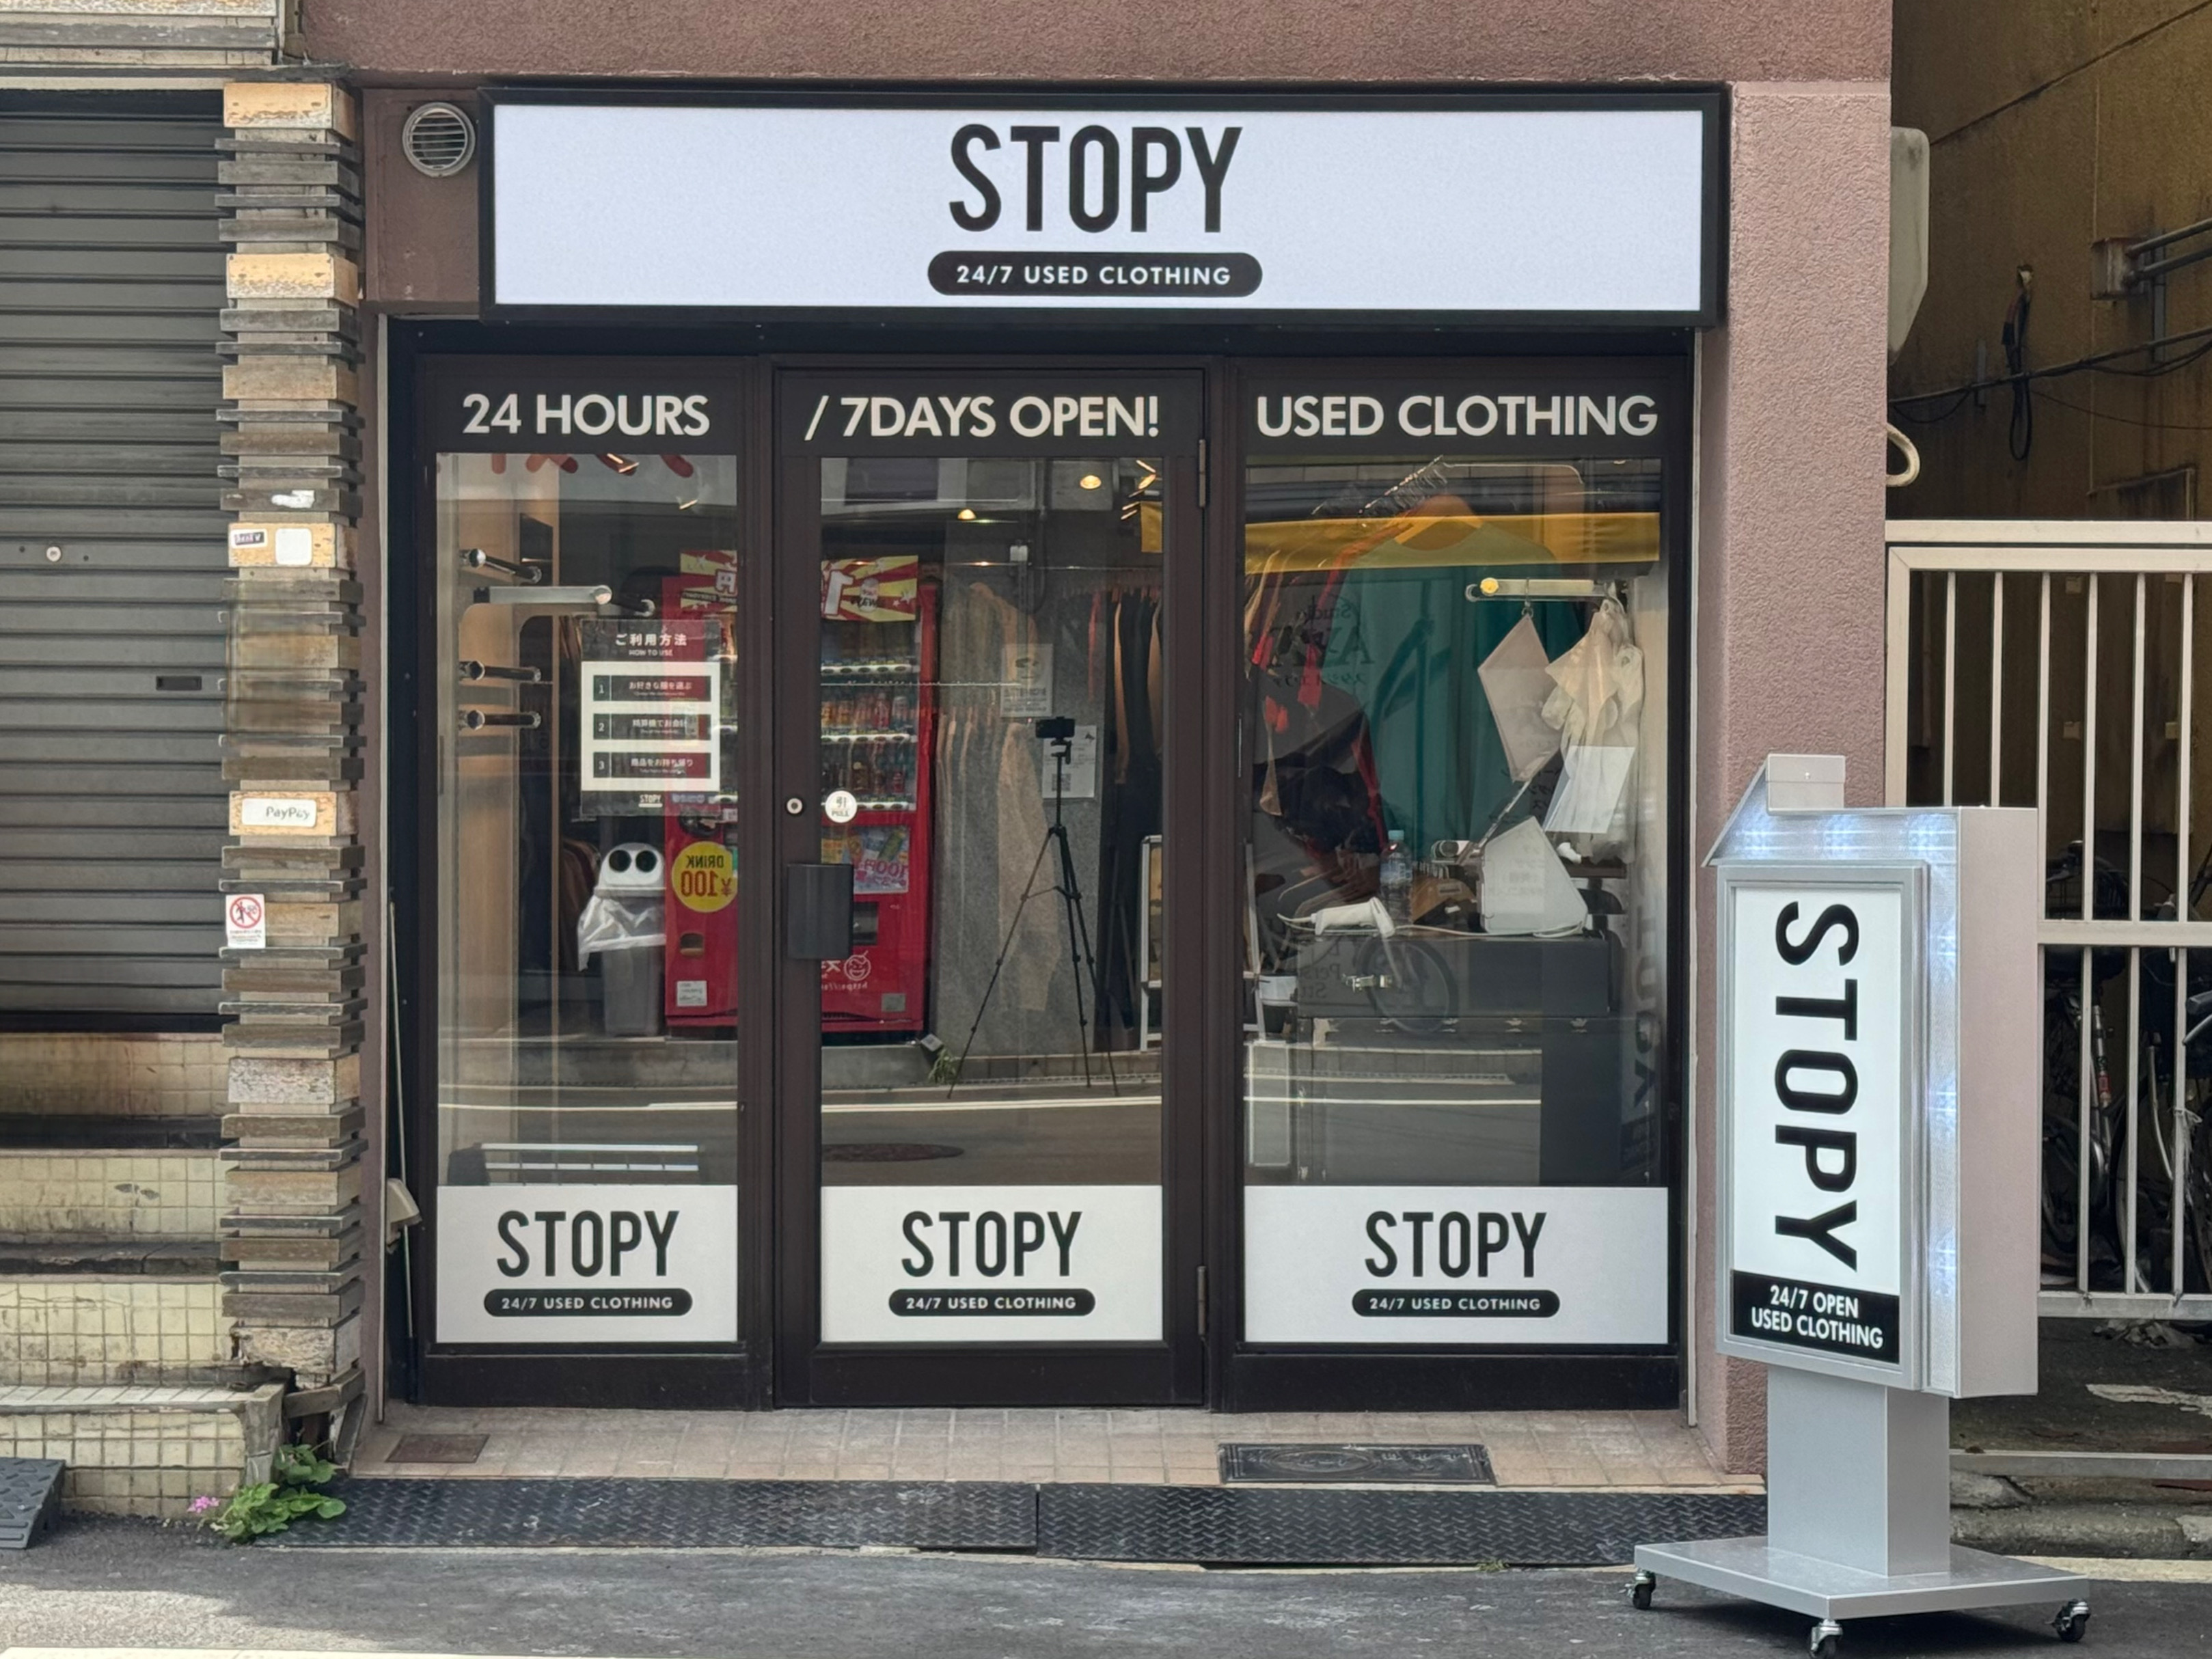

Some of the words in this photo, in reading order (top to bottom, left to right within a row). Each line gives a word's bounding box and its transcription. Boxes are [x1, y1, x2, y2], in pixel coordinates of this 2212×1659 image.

[949, 124, 1243, 233] STOPY
[957, 265, 1013, 285] 24/7
[1024, 265, 1088, 285] USED
[1099, 266, 1231, 286] CLOTHING
[463, 394, 521, 434] 24
[536, 394, 710, 436] HOURS
[841, 396, 996, 437] 7DAYS
[1009, 396, 1159, 437] OPEN!
[1257, 395, 1384, 437] USED
[1398, 395, 1658, 437] CLOTHING
[615, 633, 687, 646] ご利用方法
[599, 685, 604, 694] 1
[598, 722, 605, 732] 2
[598, 760, 605, 770] 3
[640, 794, 661, 804] STOPY
[266, 806, 310, 820] PayPay
[1774, 901, 1859, 1272] STOPY
[497, 1210, 680, 1278] STOPY
[902, 1211, 1083, 1278] STOPY
[1365, 1211, 1547, 1278] STOPY
[502, 1297, 537, 1310] 24/7
[543, 1297, 584, 1310] USED
[590, 1297, 673, 1310] CLOTHING
[906, 1297, 942, 1310] 24/7
[948, 1297, 989, 1310] USED
[994, 1297, 1076, 1310] CLOTHING
[1369, 1297, 1405, 1310] 24/7
[1411, 1297, 1452, 1310] USED
[1458, 1297, 1540, 1310] CLOTHING
[1770, 1285, 1809, 1310] 24/7
[1812, 1291, 1859, 1318] OPEN
[1751, 1306, 1792, 1332] USED
[1797, 1315, 1883, 1349] CLOTHING
